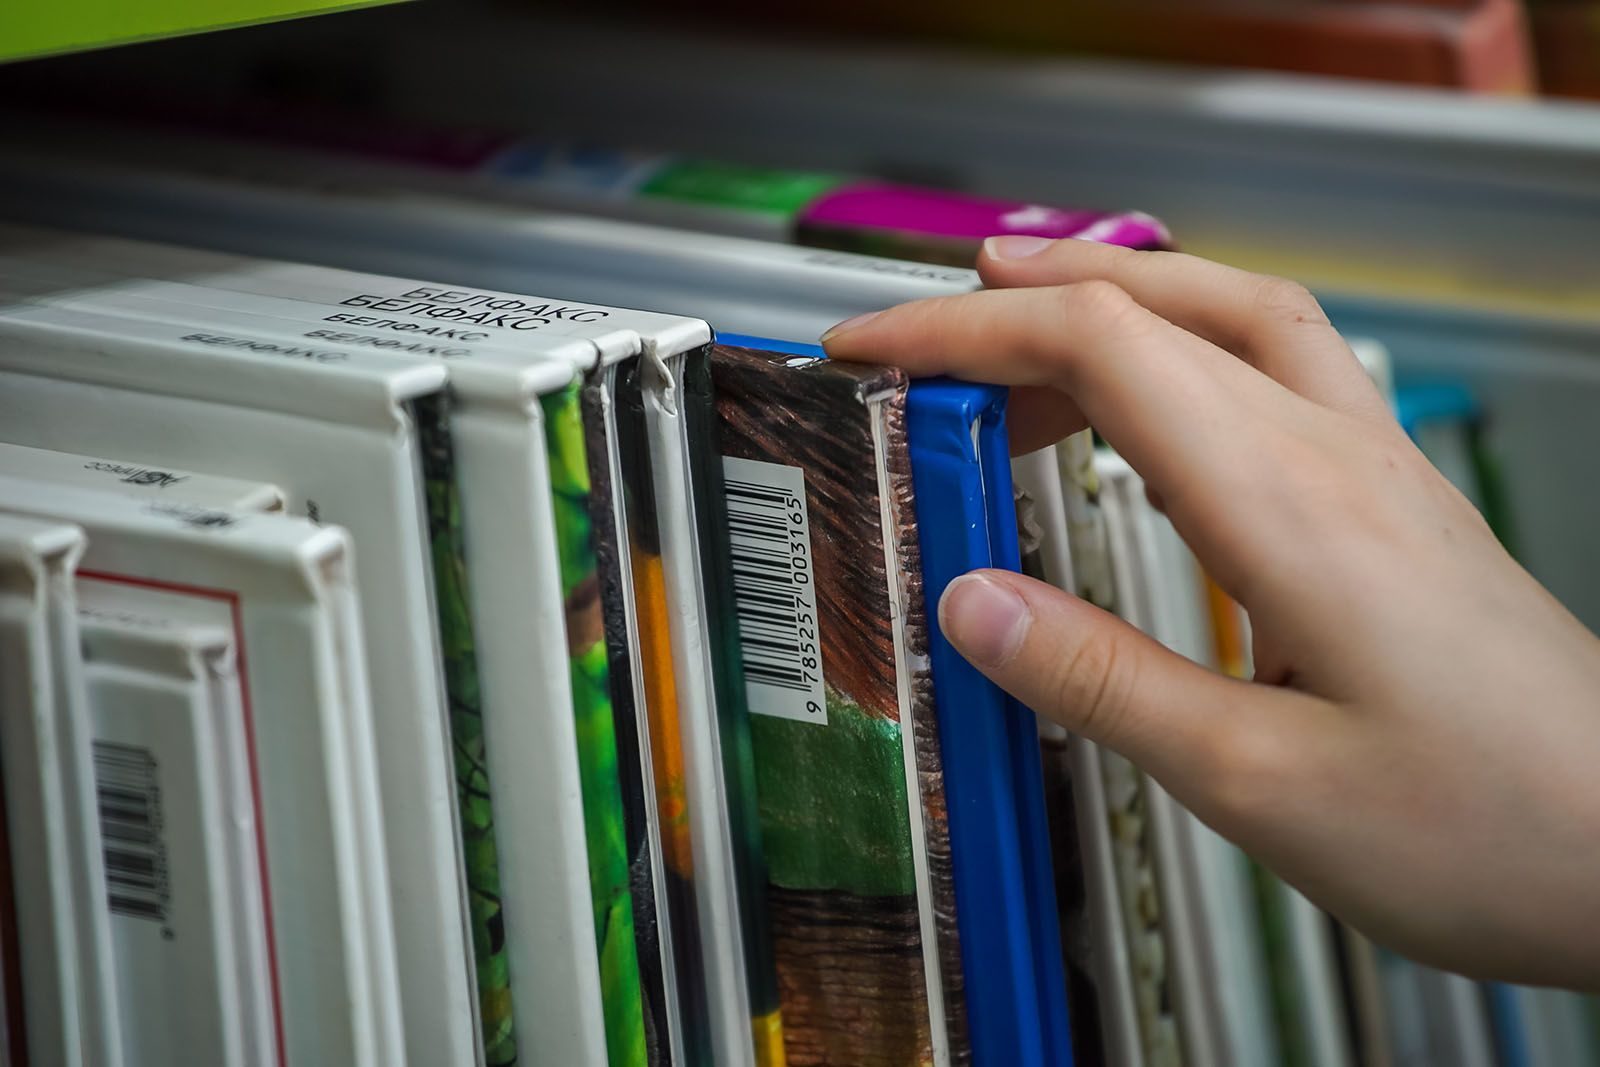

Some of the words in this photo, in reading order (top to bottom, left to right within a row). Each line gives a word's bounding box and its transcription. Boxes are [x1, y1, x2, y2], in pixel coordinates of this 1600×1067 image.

[339, 294, 551, 331] БЕЛФАКС
[400, 287, 609, 323] БЕЛФАКС
[303, 329, 473, 358] БЕЛФАКС
[322, 313, 489, 342] БЕЛФАКС
[786, 498, 809, 584] 003165
[796, 596, 819, 684] 785257
[806, 701, 822, 713] 9
